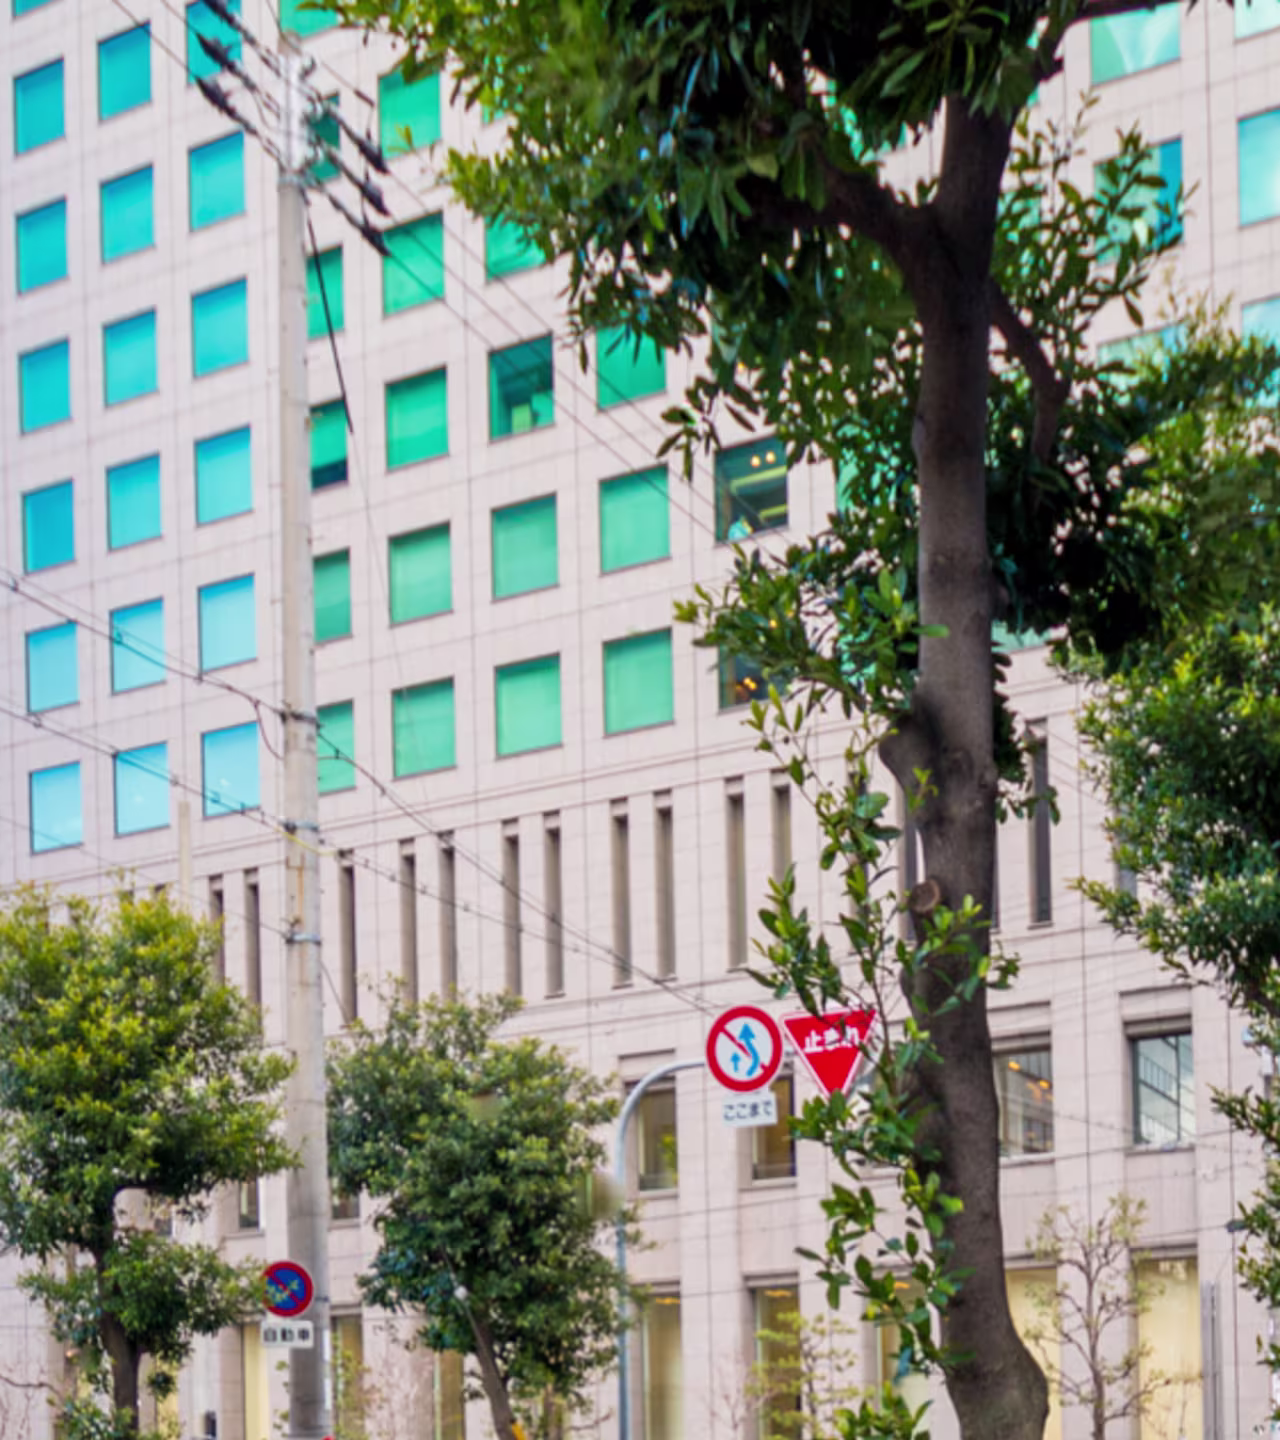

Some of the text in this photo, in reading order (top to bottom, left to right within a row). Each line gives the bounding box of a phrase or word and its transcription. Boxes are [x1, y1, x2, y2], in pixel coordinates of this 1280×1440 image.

[803, 1025, 861, 1054] 止まれ
[723, 1100, 772, 1121] ここまで
[263, 1327, 310, 1342] 自動車
